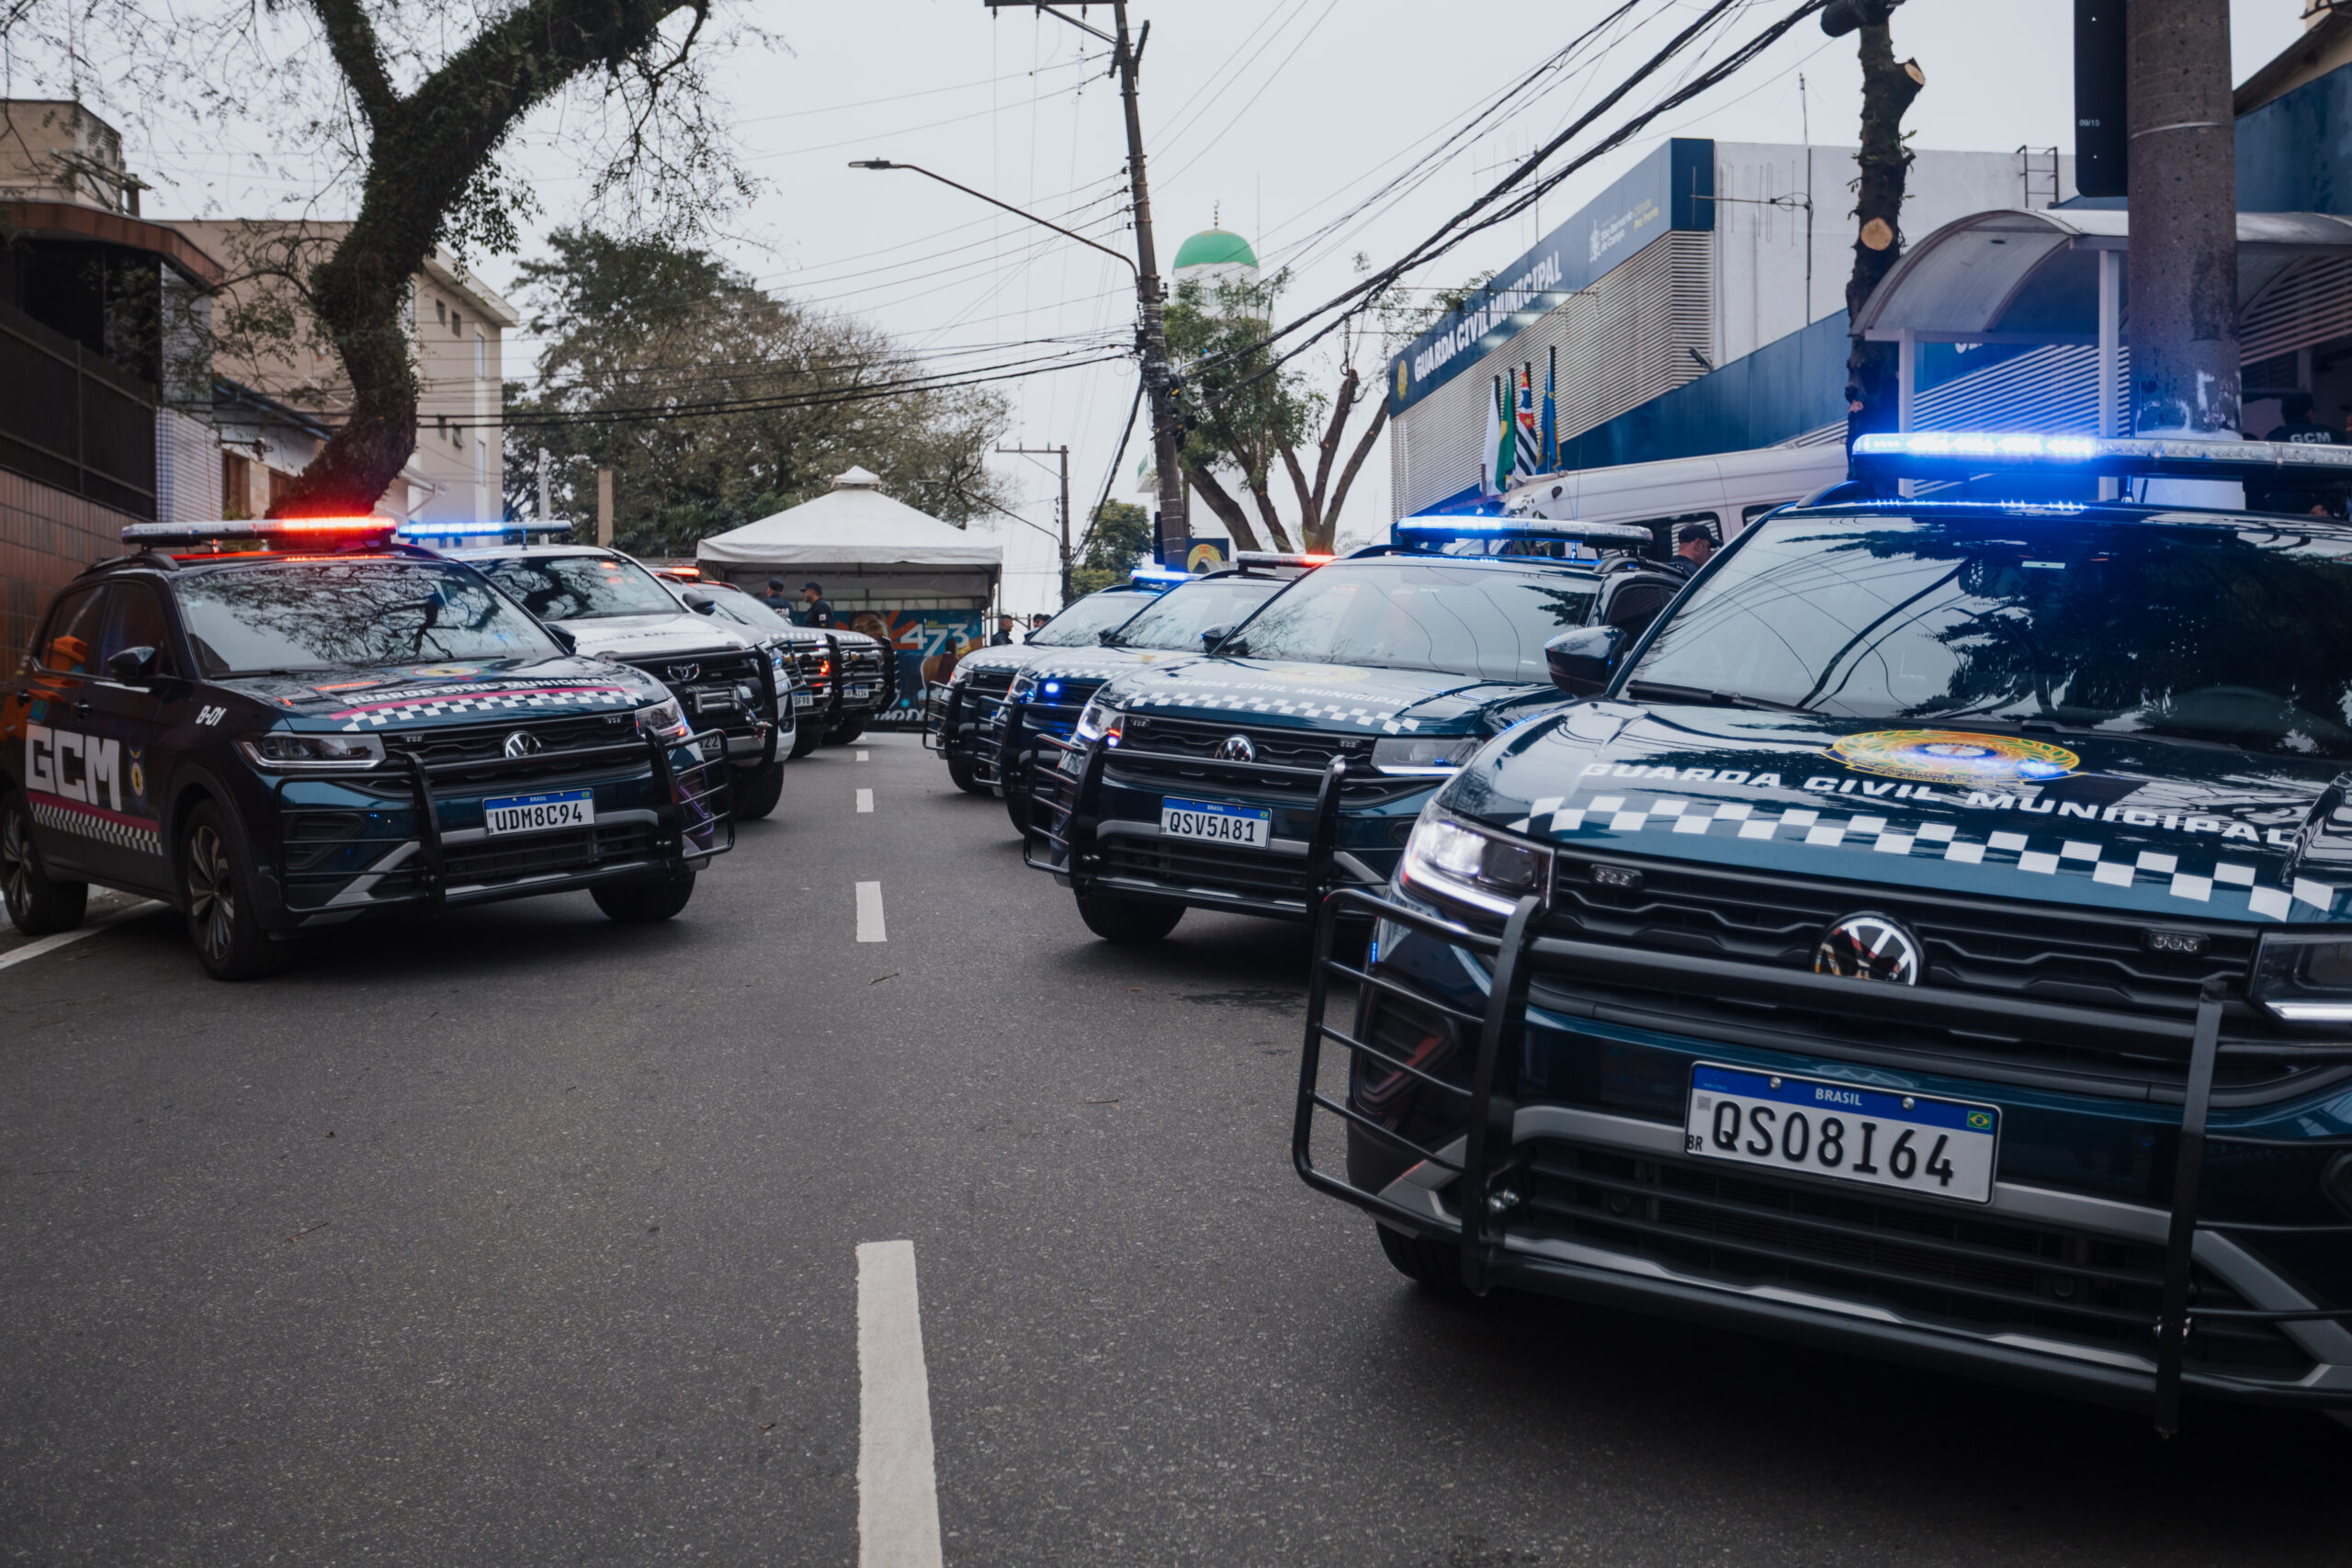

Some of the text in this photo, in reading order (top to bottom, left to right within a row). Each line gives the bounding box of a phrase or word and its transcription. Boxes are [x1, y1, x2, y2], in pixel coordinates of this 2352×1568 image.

[1414, 251, 1562, 382] GUARDA CIVIL MUNICIPAL
[2290, 432, 2331, 444] GCM
[900, 623, 970, 657] 473
[342, 690, 436, 705] GUARDA
[440, 683, 500, 694] CIVIL
[26, 724, 122, 812] GCM
[495, 803, 582, 831] UDM8C94
[1580, 763, 2299, 849] GUARDA CIVIL MUNICIPAL
[1170, 812, 1255, 842] QSV5A81
[1815, 1088, 1862, 1107] BRASIL
[1688, 1134, 1703, 1152] BR
